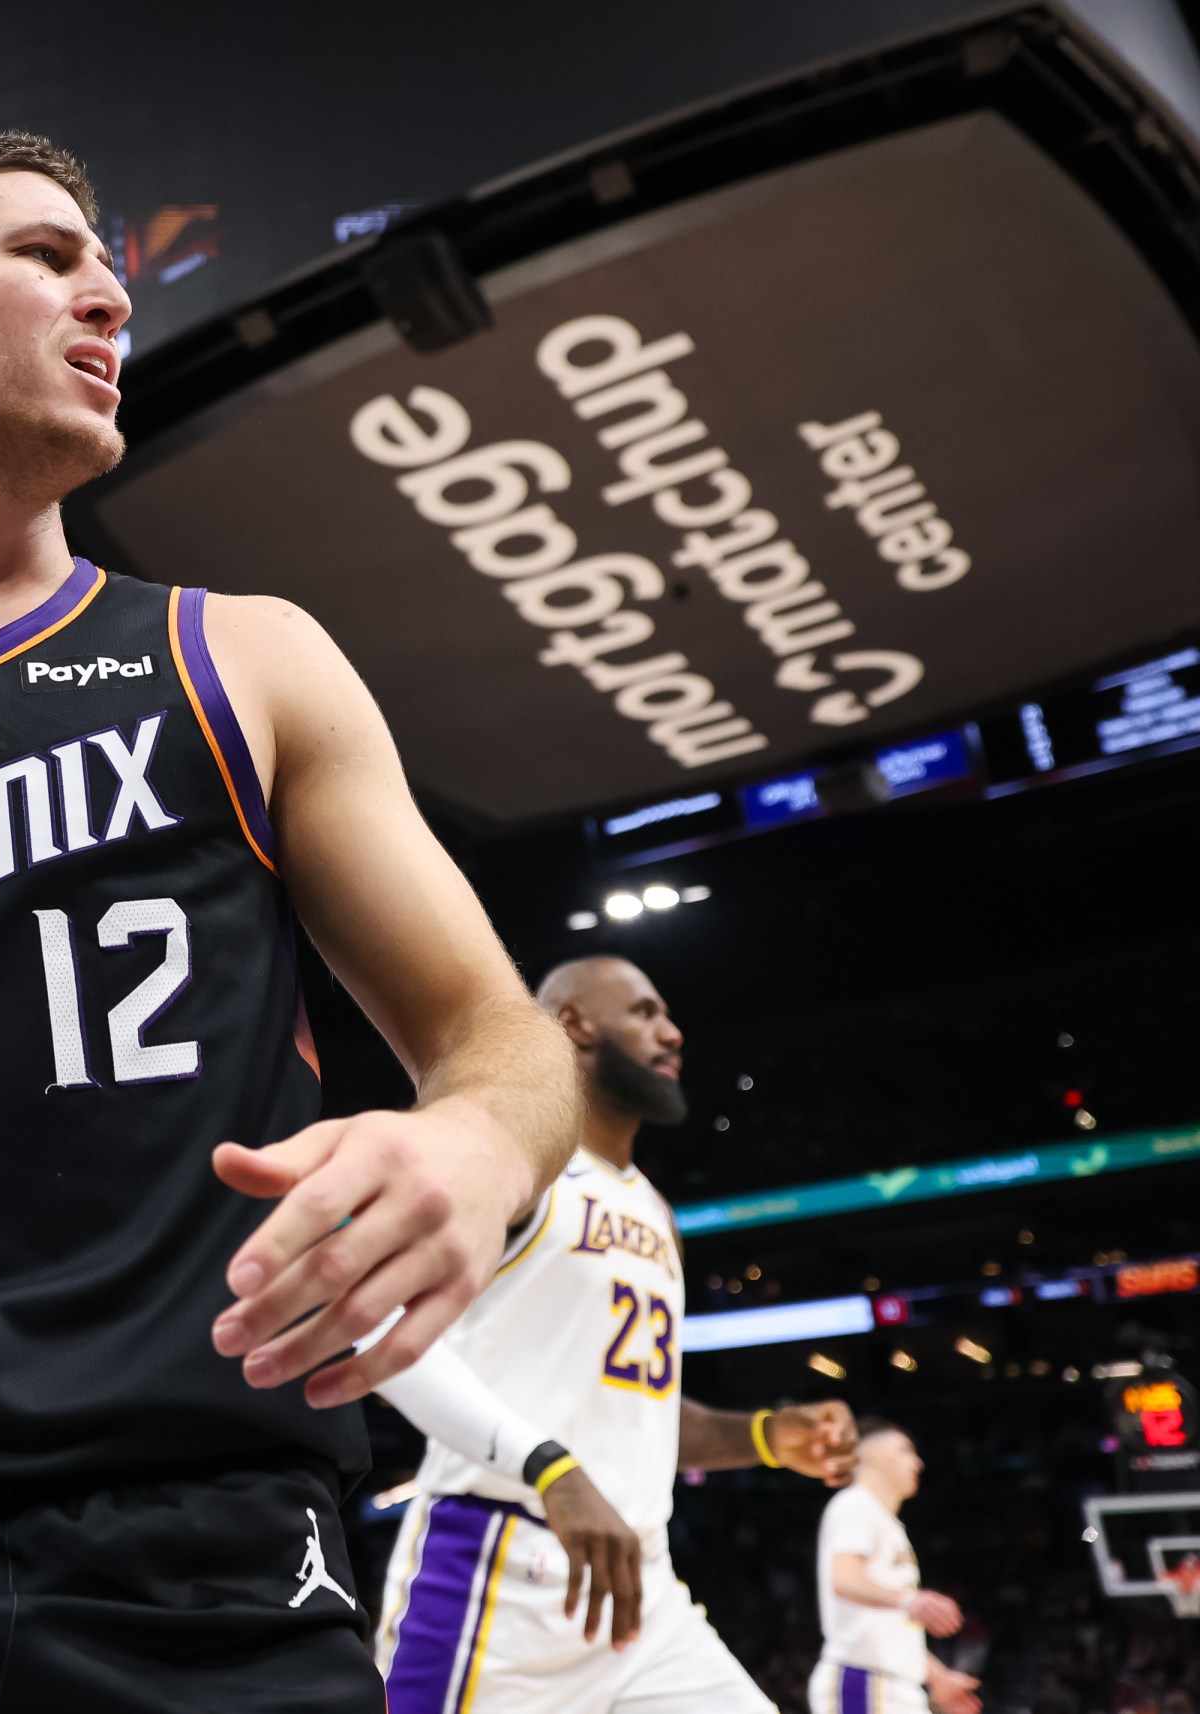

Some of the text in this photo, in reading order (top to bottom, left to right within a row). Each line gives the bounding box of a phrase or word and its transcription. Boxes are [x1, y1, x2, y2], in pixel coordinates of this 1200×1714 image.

[350, 386, 769, 769] mortgage
[536, 314, 856, 657] matchup
[797, 409, 973, 593] center
[26, 654, 155, 687] PayPal
[32, 897, 202, 1090] 12
[601, 1275, 678, 1401] 23
